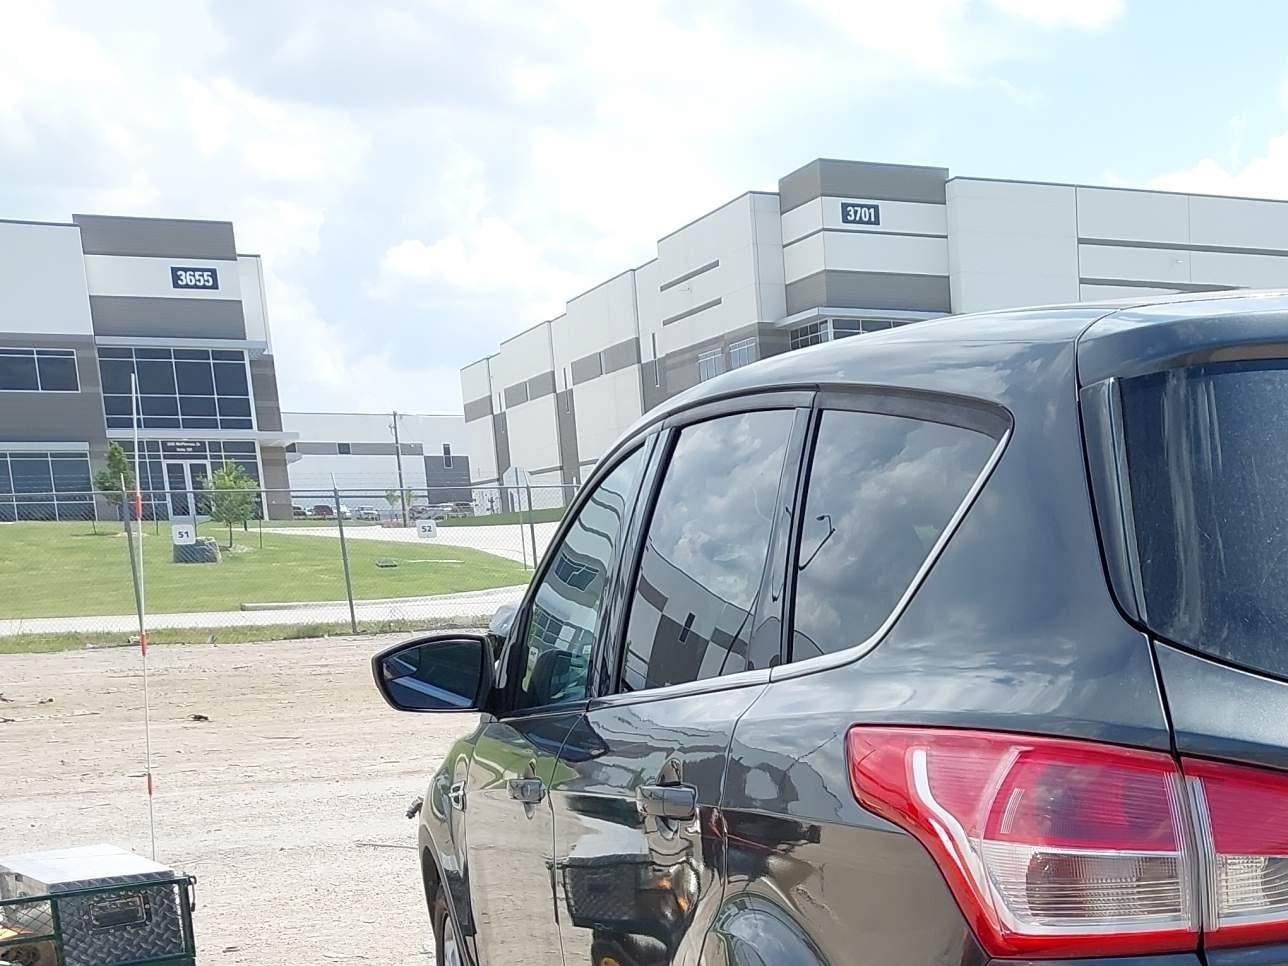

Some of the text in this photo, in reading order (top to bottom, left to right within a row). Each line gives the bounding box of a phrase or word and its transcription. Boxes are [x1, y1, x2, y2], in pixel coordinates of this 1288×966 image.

[847, 206, 875, 222] 3701
[176, 270, 213, 286] 3655
[178, 530, 190, 539] 51
[421, 525, 432, 533] 52
